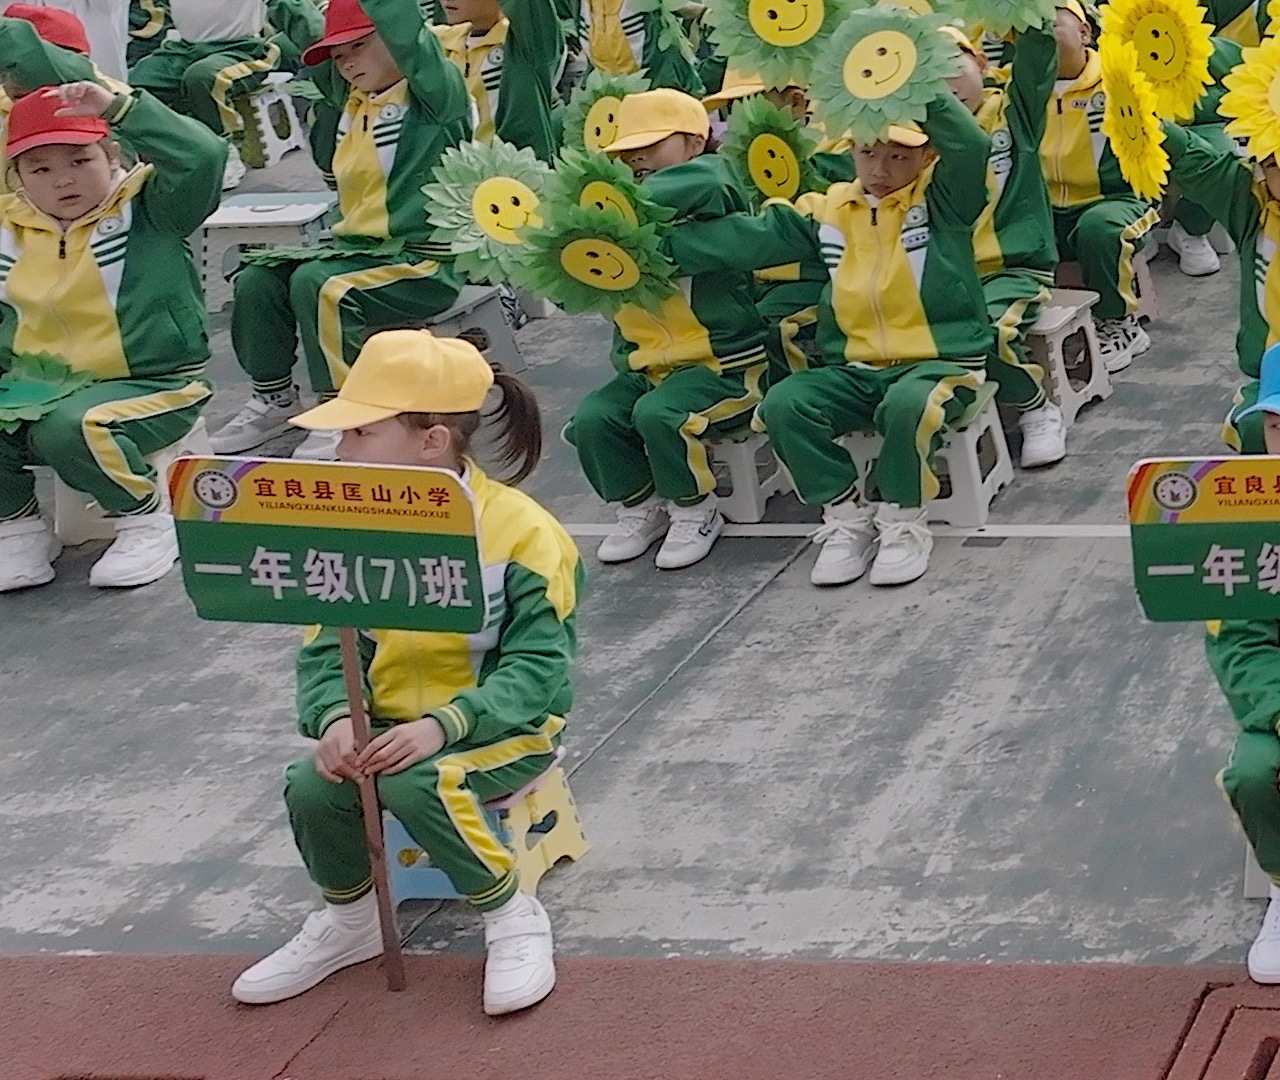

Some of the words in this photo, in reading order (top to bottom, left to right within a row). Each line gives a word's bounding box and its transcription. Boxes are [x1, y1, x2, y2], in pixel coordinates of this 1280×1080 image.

[254, 477, 450, 507] 宜良县匡山小学
[258, 500, 450, 520] YILIANGXIANKUANGSHANXIAOXUE
[194, 546, 473, 609] 一年级(7)班
